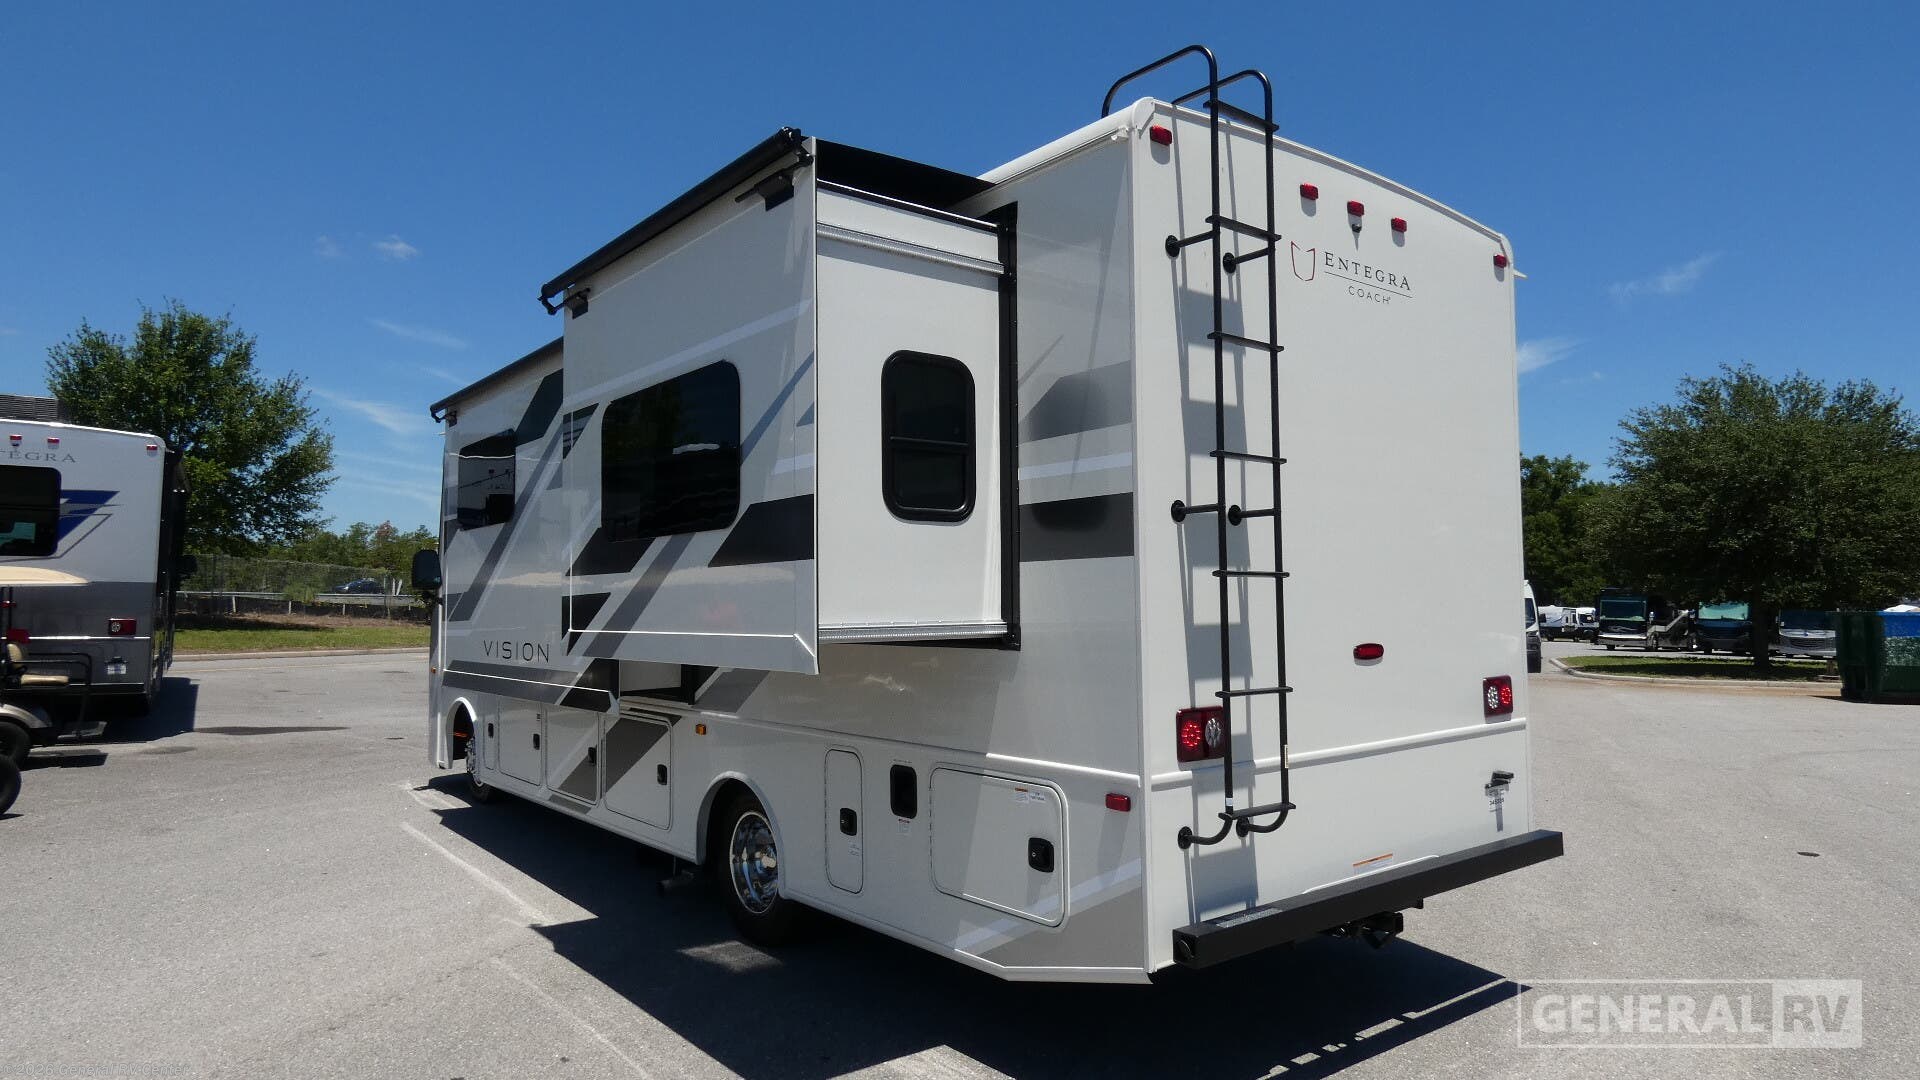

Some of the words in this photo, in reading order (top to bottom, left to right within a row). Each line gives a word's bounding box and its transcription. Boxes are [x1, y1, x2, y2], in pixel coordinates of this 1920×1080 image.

[1324, 251, 1411, 290] ENTEGRA
[1348, 285, 1390, 304] COACH
[483, 640, 549, 663] VISION
